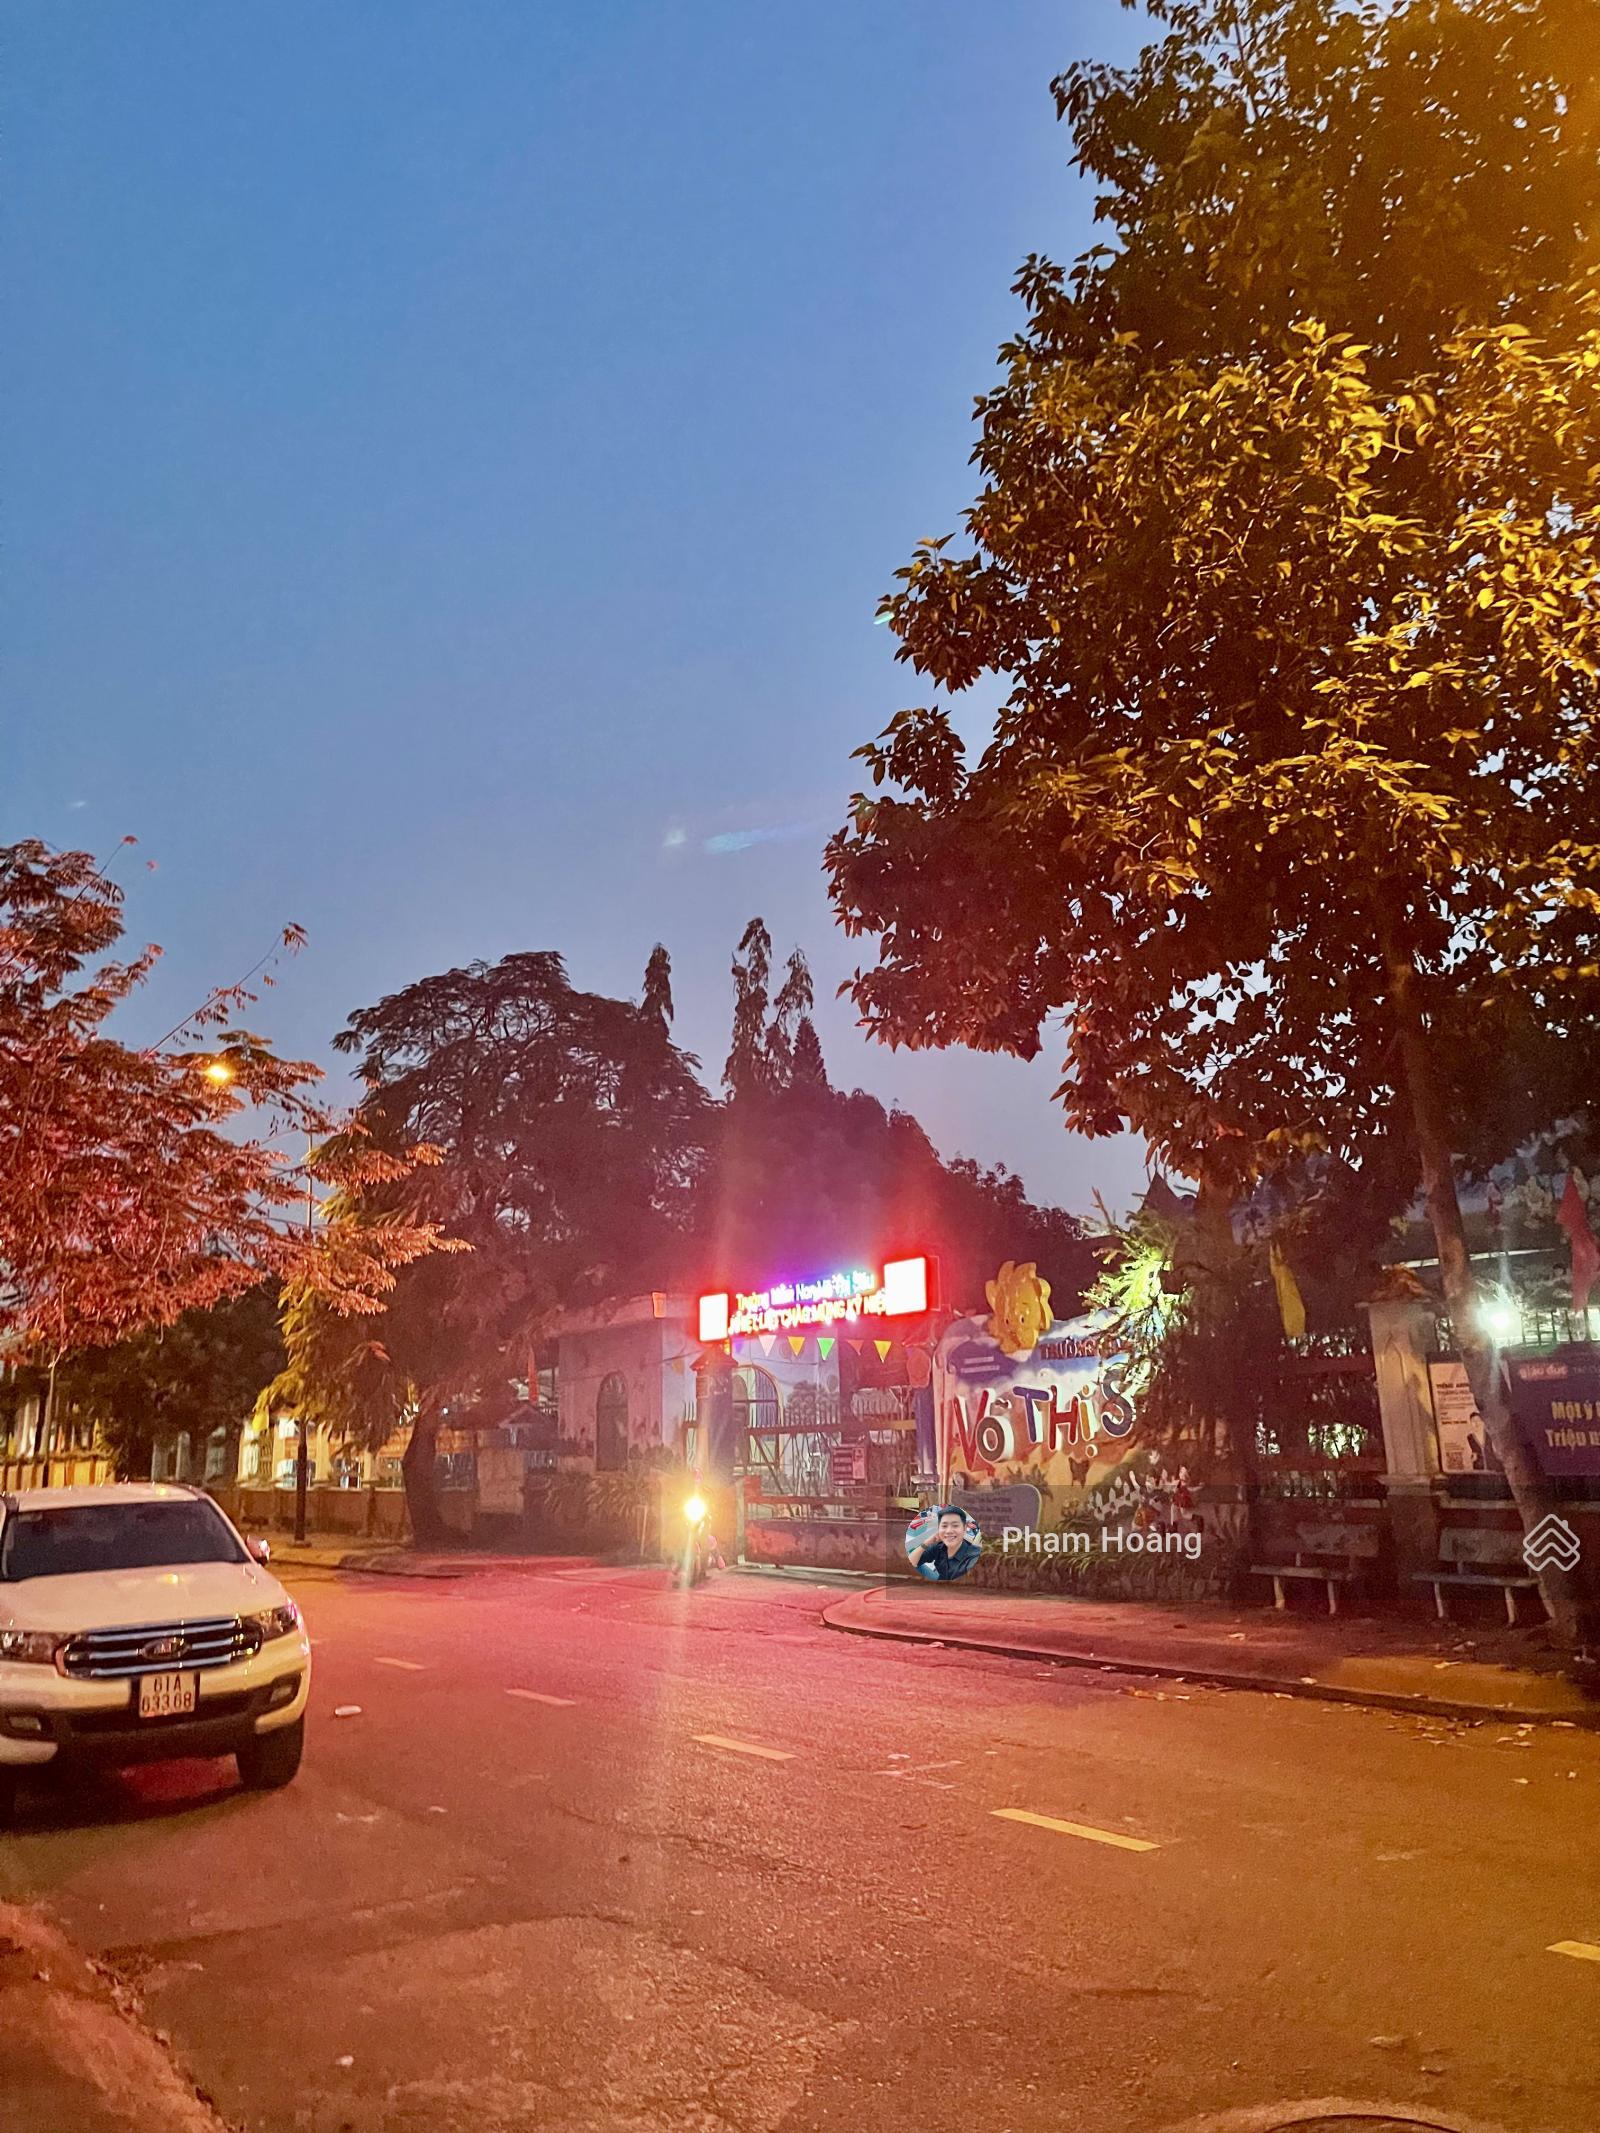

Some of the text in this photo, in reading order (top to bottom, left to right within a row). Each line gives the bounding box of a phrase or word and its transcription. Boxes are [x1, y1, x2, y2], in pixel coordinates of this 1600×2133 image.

[953, 1366, 1137, 1472] VÕ THỊ S
